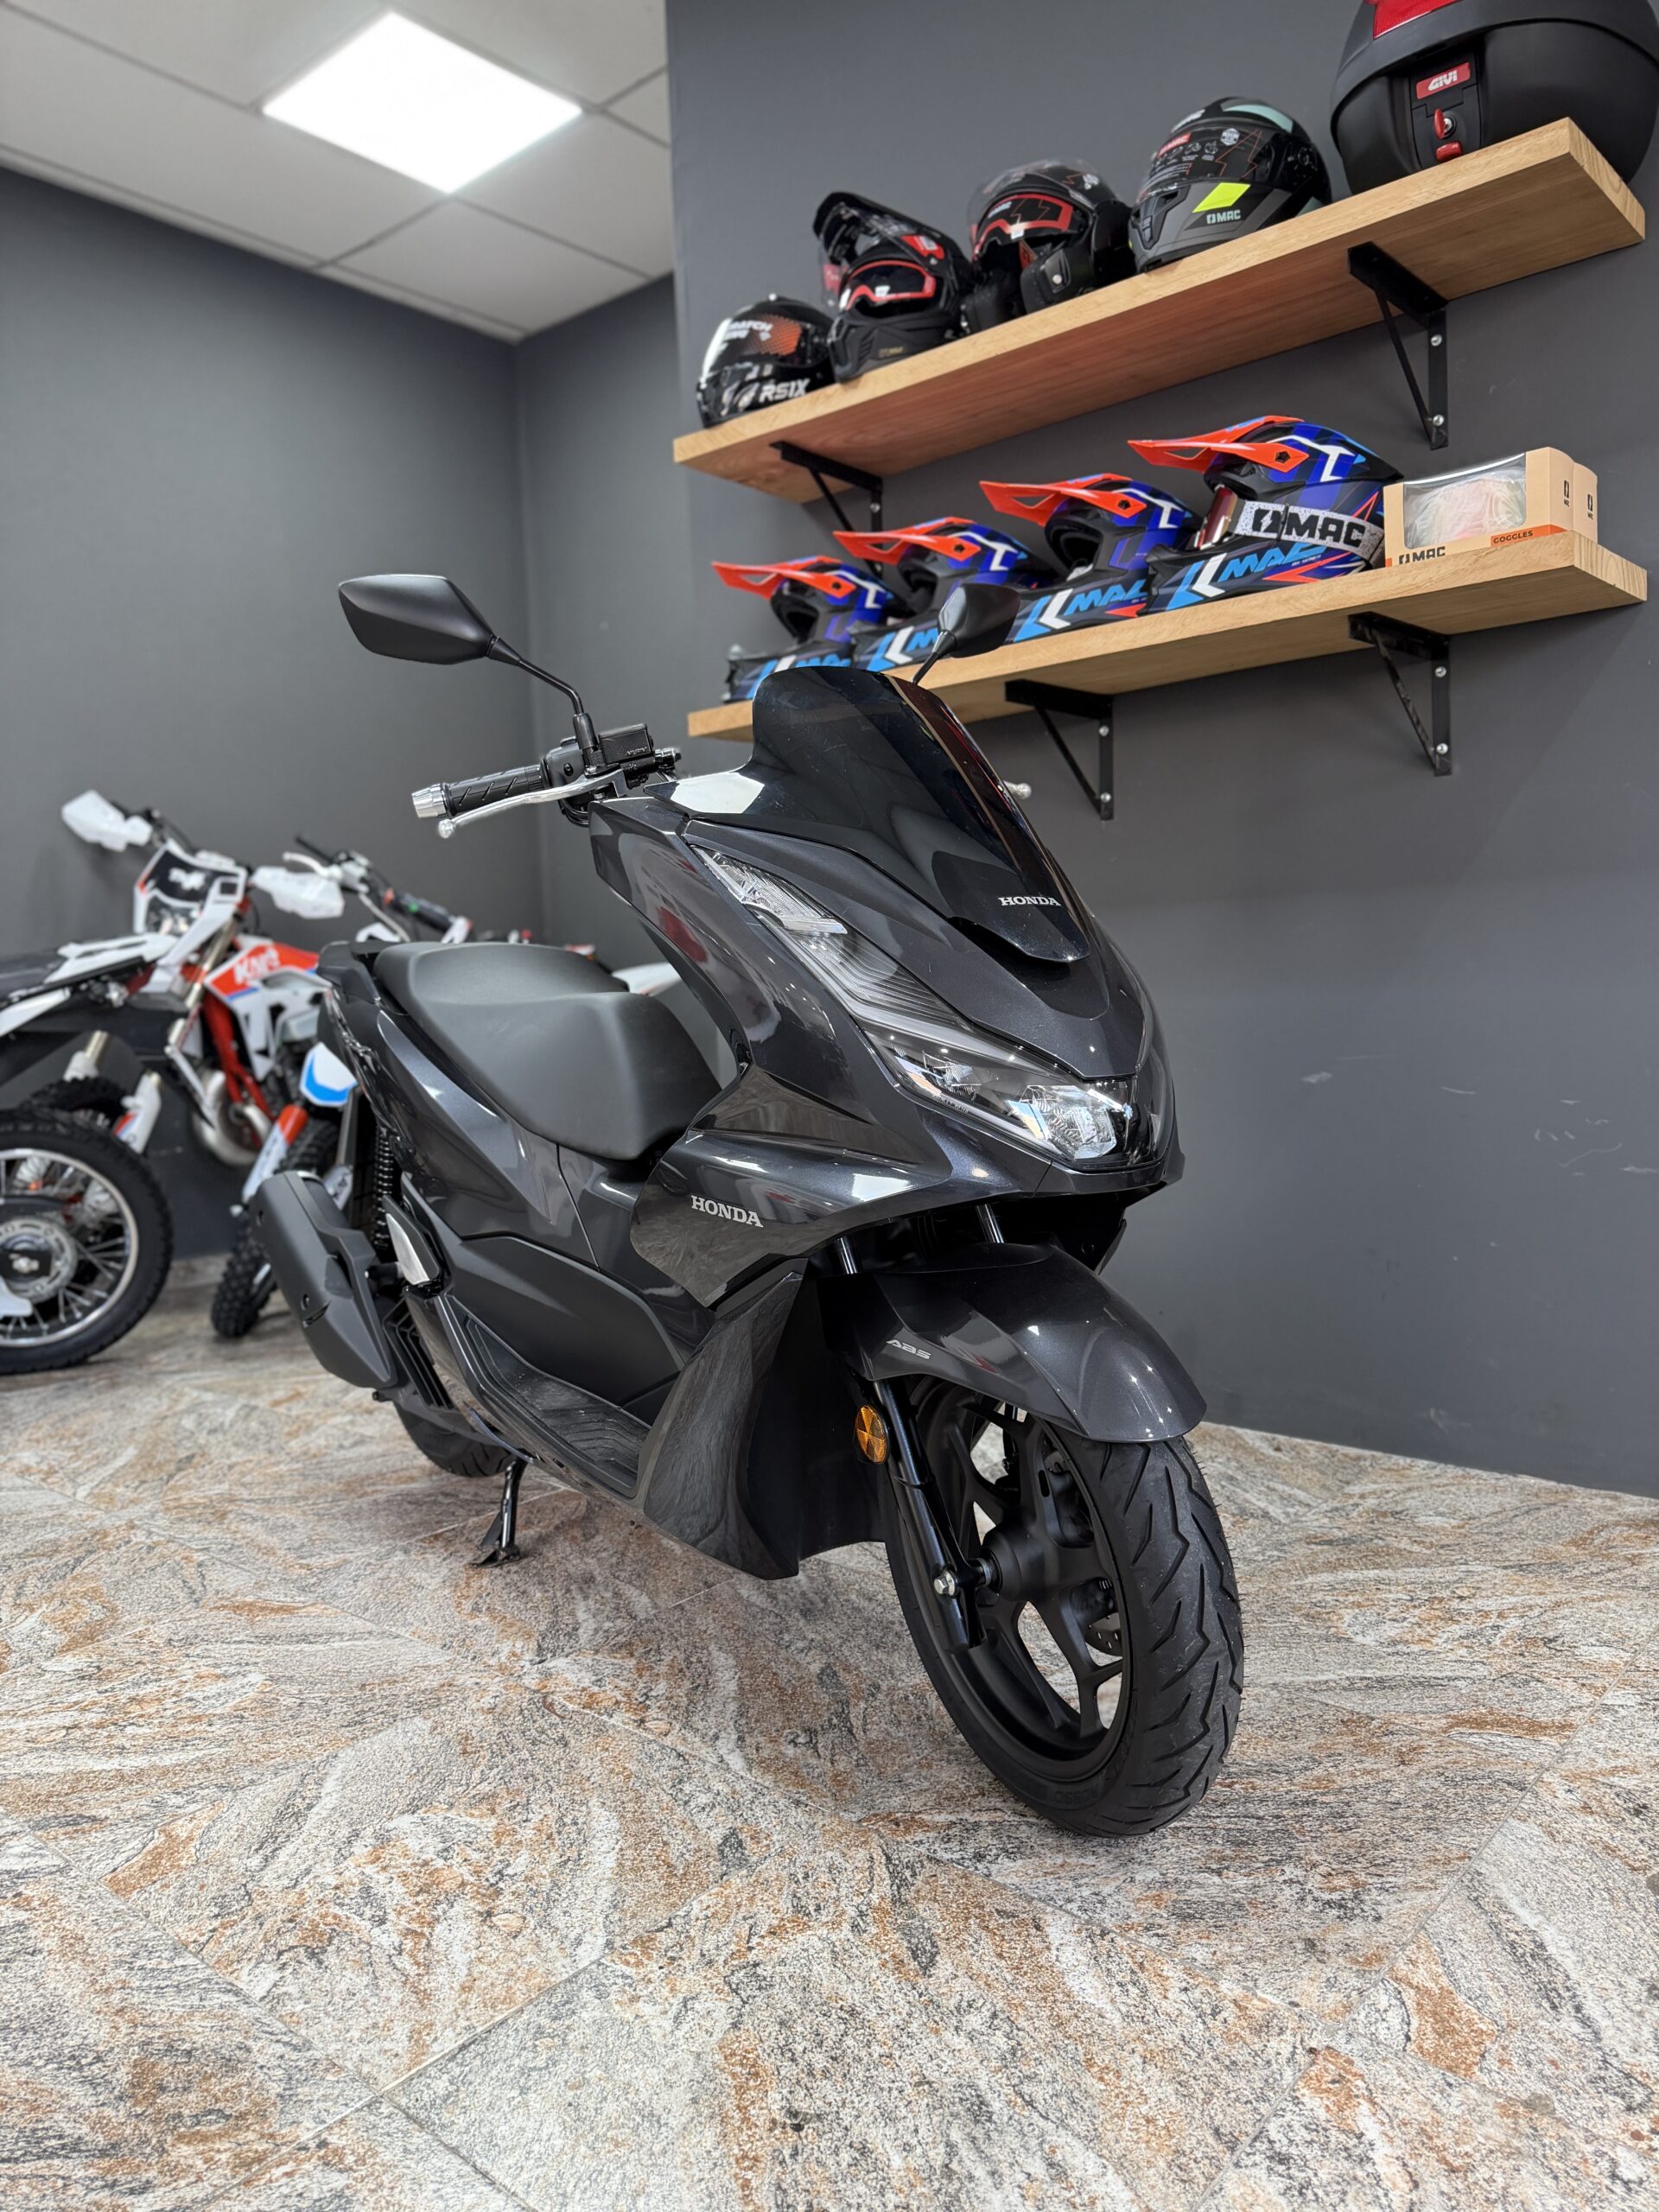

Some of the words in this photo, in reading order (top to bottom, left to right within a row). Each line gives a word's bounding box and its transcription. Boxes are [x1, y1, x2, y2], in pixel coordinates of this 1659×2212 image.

[1428, 69, 1458, 91] GIVI
[1217, 209, 1242, 223] MAC
[759, 378, 810, 403] RSIX
[1283, 512, 1366, 548] MAC
[1493, 530, 1534, 544] GOGGLES
[1412, 546, 1446, 563] MAC
[997, 896, 1062, 906] HONDA
[690, 1194, 764, 1228] HONDA
[886, 1338, 931, 1360] ABS
